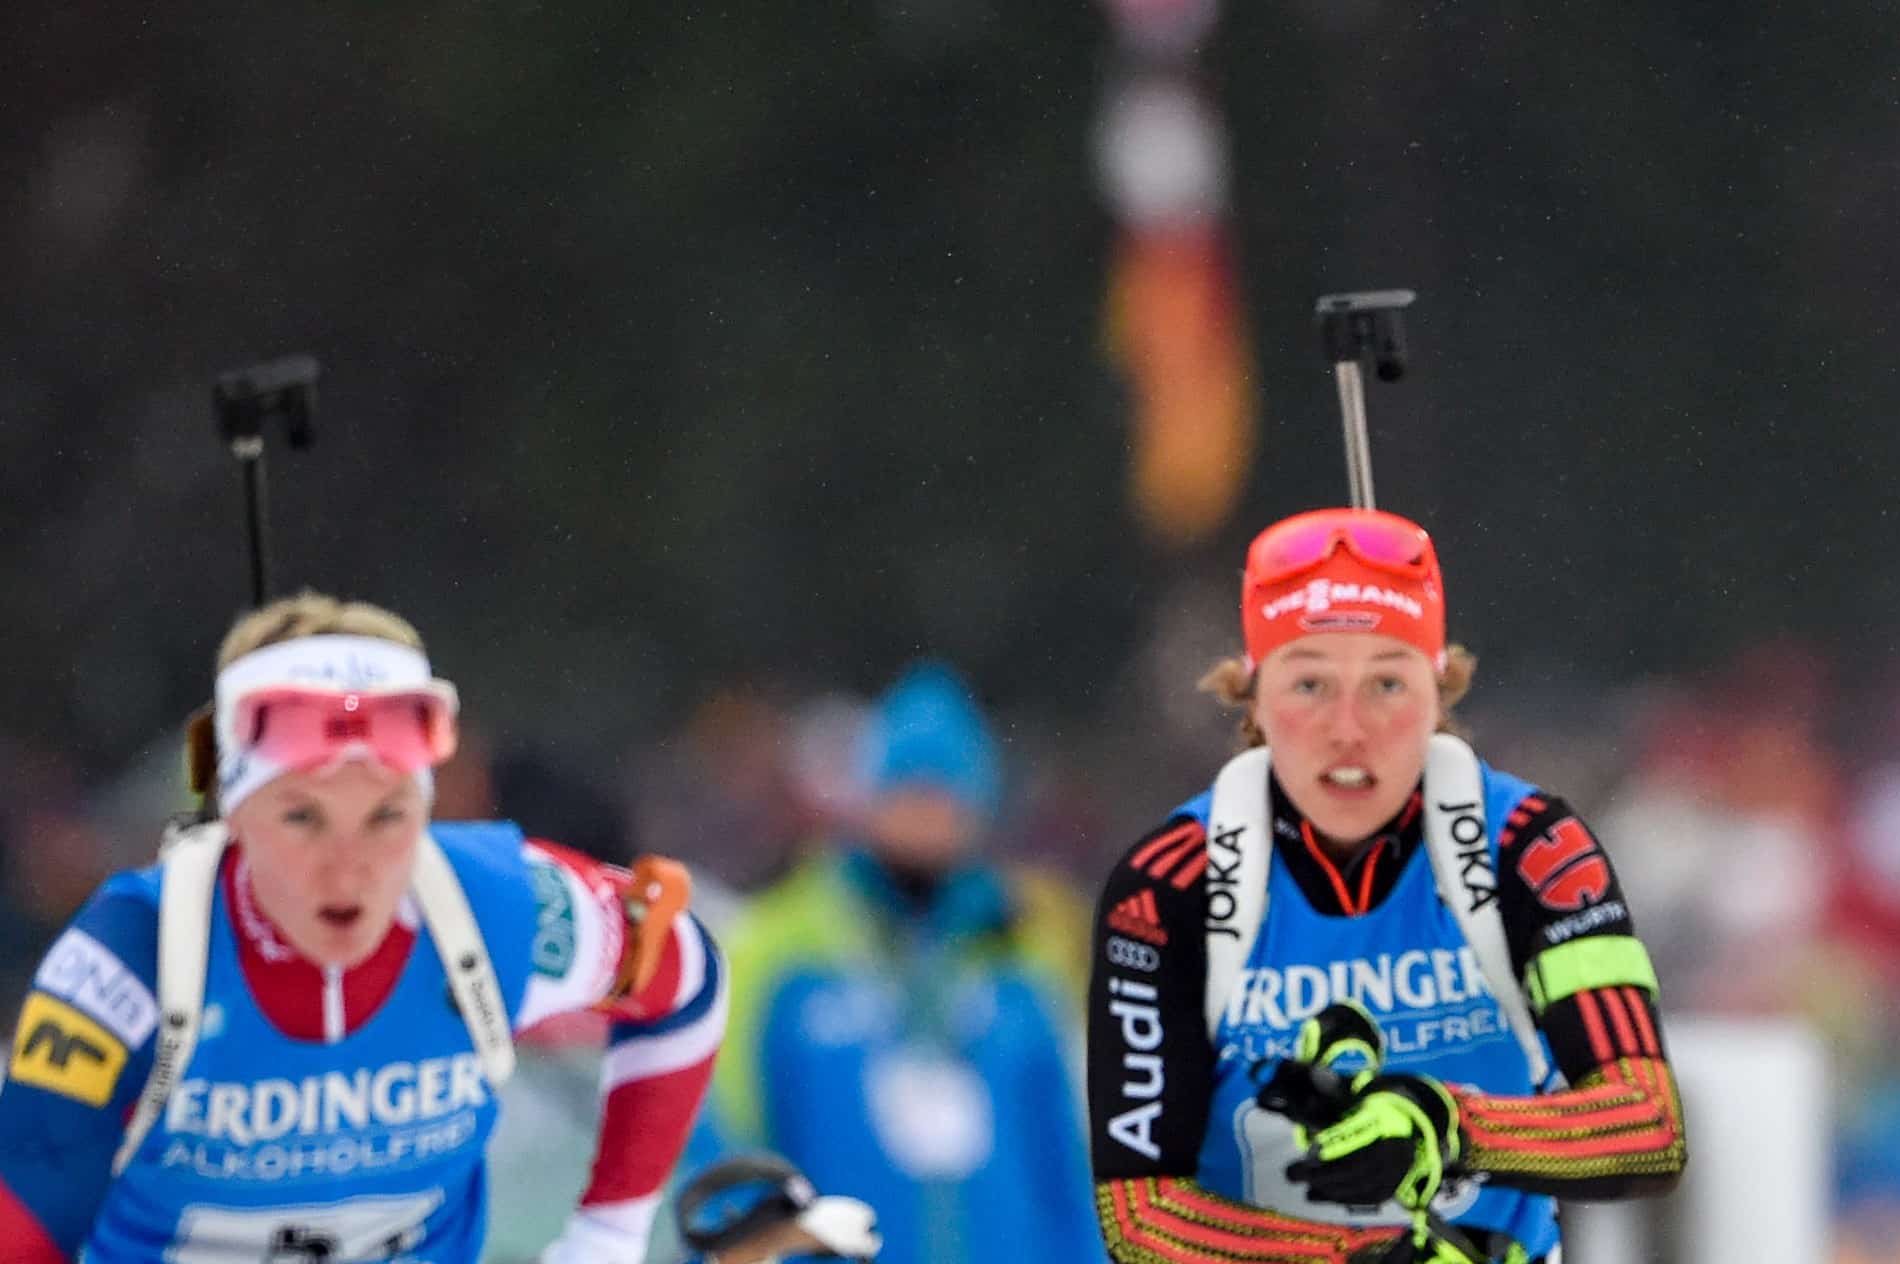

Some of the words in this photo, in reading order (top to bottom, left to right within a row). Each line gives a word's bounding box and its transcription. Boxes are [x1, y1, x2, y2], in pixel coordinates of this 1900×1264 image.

[1205, 825, 1246, 940] JOKA
[1434, 802, 1499, 912] JOKA
[164, 1052, 486, 1146] ERDINGER
[1108, 976, 1164, 1160] Audi
